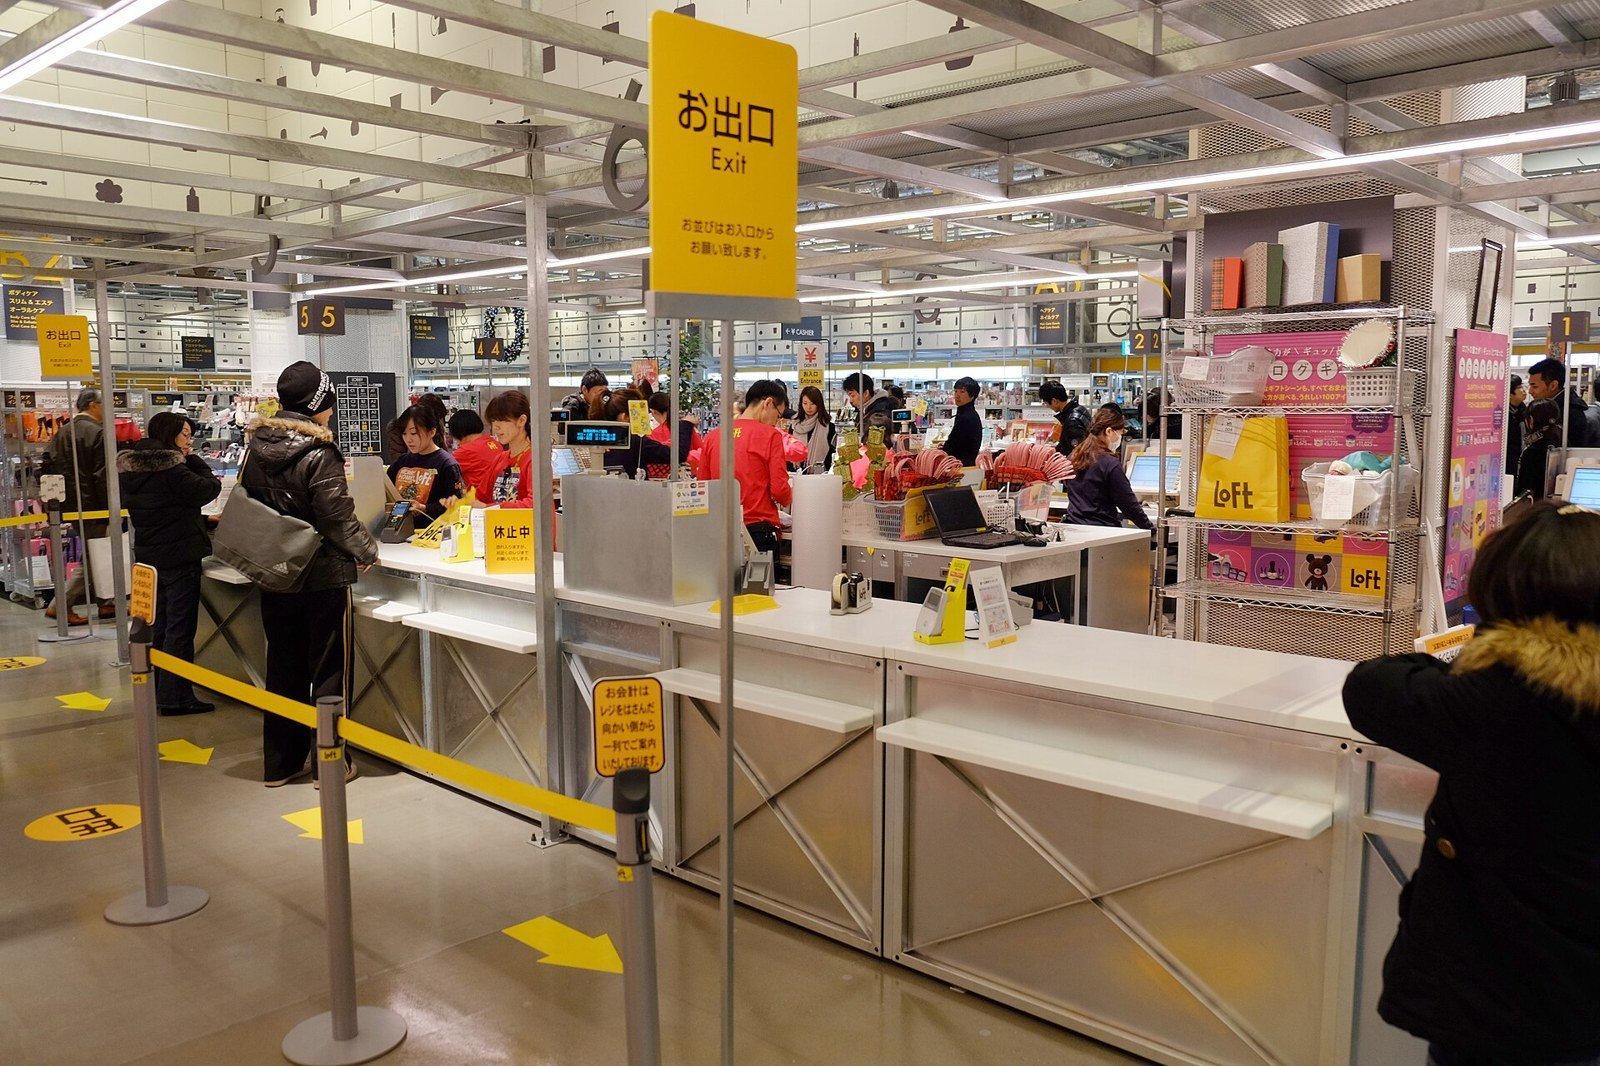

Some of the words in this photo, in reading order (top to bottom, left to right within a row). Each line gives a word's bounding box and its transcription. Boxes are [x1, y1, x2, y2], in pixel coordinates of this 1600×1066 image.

[678, 89, 774, 147] お出口
[711, 148, 747, 174] Exit
[682, 218, 775, 240] お並びはお入口から
[690, 241, 767, 260] お願い致します。
[301, 305, 309, 328] 5
[321, 305, 336, 328] 5
[1562, 316, 1571, 336] 1
[46, 330, 81, 340] お出口
[1134, 333, 1145, 350] 2
[1153, 333, 1159, 349] 2
[477, 341, 484, 356] 4
[491, 341, 500, 356] 4
[851, 345, 859, 359] 3
[864, 344, 872, 358] 3
[493, 525, 530, 539] 休止中
[606, 685, 649, 699] お会計は
[601, 702, 655, 716] レジをはさんだ
[602, 720, 655, 735] 向かい側から
[603, 738, 656, 752] 一列でご案内
